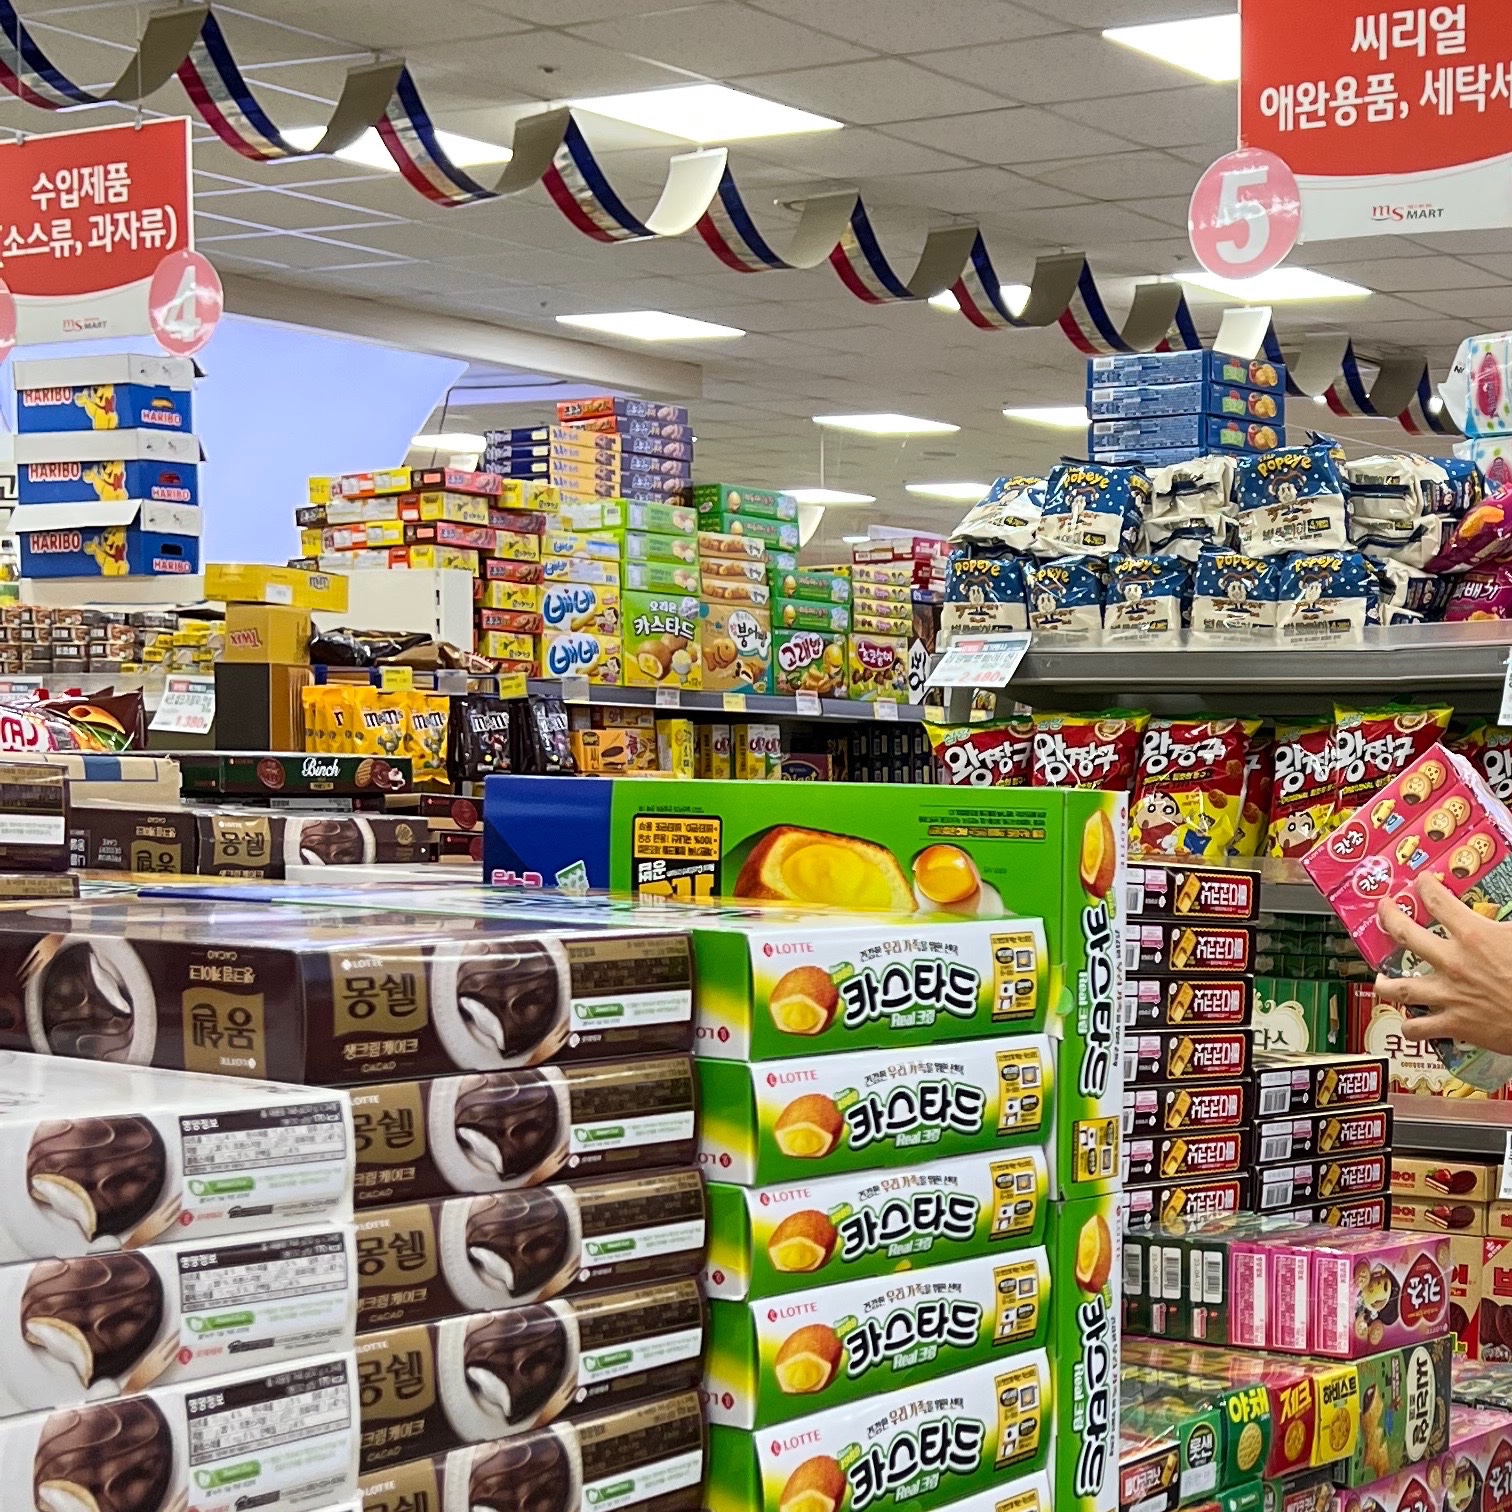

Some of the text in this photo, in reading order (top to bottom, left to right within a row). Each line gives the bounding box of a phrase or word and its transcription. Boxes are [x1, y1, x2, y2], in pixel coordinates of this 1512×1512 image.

[1350, 4, 1467, 61] 씨리얼
[1259, 72, 1408, 133] 애완용품,
[31, 162, 132, 211] 수입제품
[88, 204, 178, 253] 과자류)
[1215, 167, 1270, 264] 5
[1405, 207, 1444, 220] MART
[160, 264, 203, 342] 4
[84, 320, 108, 330] MART
[23, 386, 74, 407] HARIBO
[141, 409, 182, 426] HARIBO
[28, 461, 81, 482] HARIBO
[1256, 454, 1312, 478] POPEYE
[151, 486, 191, 502] HARIBO
[30, 531, 83, 554] HARIBO
[152, 557, 193, 574] HARIBO
[954, 559, 1001, 577] POPEYE
[632, 614, 696, 641] 카스타드
[779, 635, 824, 665] 고래밥
[858, 645, 894, 664] 초코송이
[301, 757, 341, 777] Binch
[944, 740, 1031, 787] 왕짱구
[1033, 732, 1119, 784] 왕짱구
[1139, 728, 1227, 777] 왕짱구
[1335, 730, 1415, 783] 왕짱구
[219, 830, 268, 857] 몽쉘
[1332, 828, 1364, 855] 칸쵸
[1357, 868, 1389, 895] 칸쵸
[775, 941, 815, 956] LOTTE
[882, 939, 902, 956] 우리
[342, 972, 419, 1020] 몽쉘
[838, 958, 982, 1028] 카스타드
[779, 1068, 818, 1085] LOTTE
[354, 1098, 416, 1153] 몽쉘
[844, 1078, 985, 1149] 카스타드
[771, 1188, 811, 1204] LOTTE
[837, 1193, 980, 1262] 카스타드
[358, 1218, 427, 1277] 몽쉘
[779, 1302, 818, 1320] LOTTE
[842, 1297, 982, 1377] 카스타드
[1229, 1383, 1270, 1423] 야채
[1278, 1378, 1313, 1419] 제크
[1321, 1373, 1359, 1406] 하베스트
[783, 1429, 822, 1452] LOTTE
[1186, 1430, 1215, 1464] 롯샌
[848, 1415, 985, 1511] 카스타드
